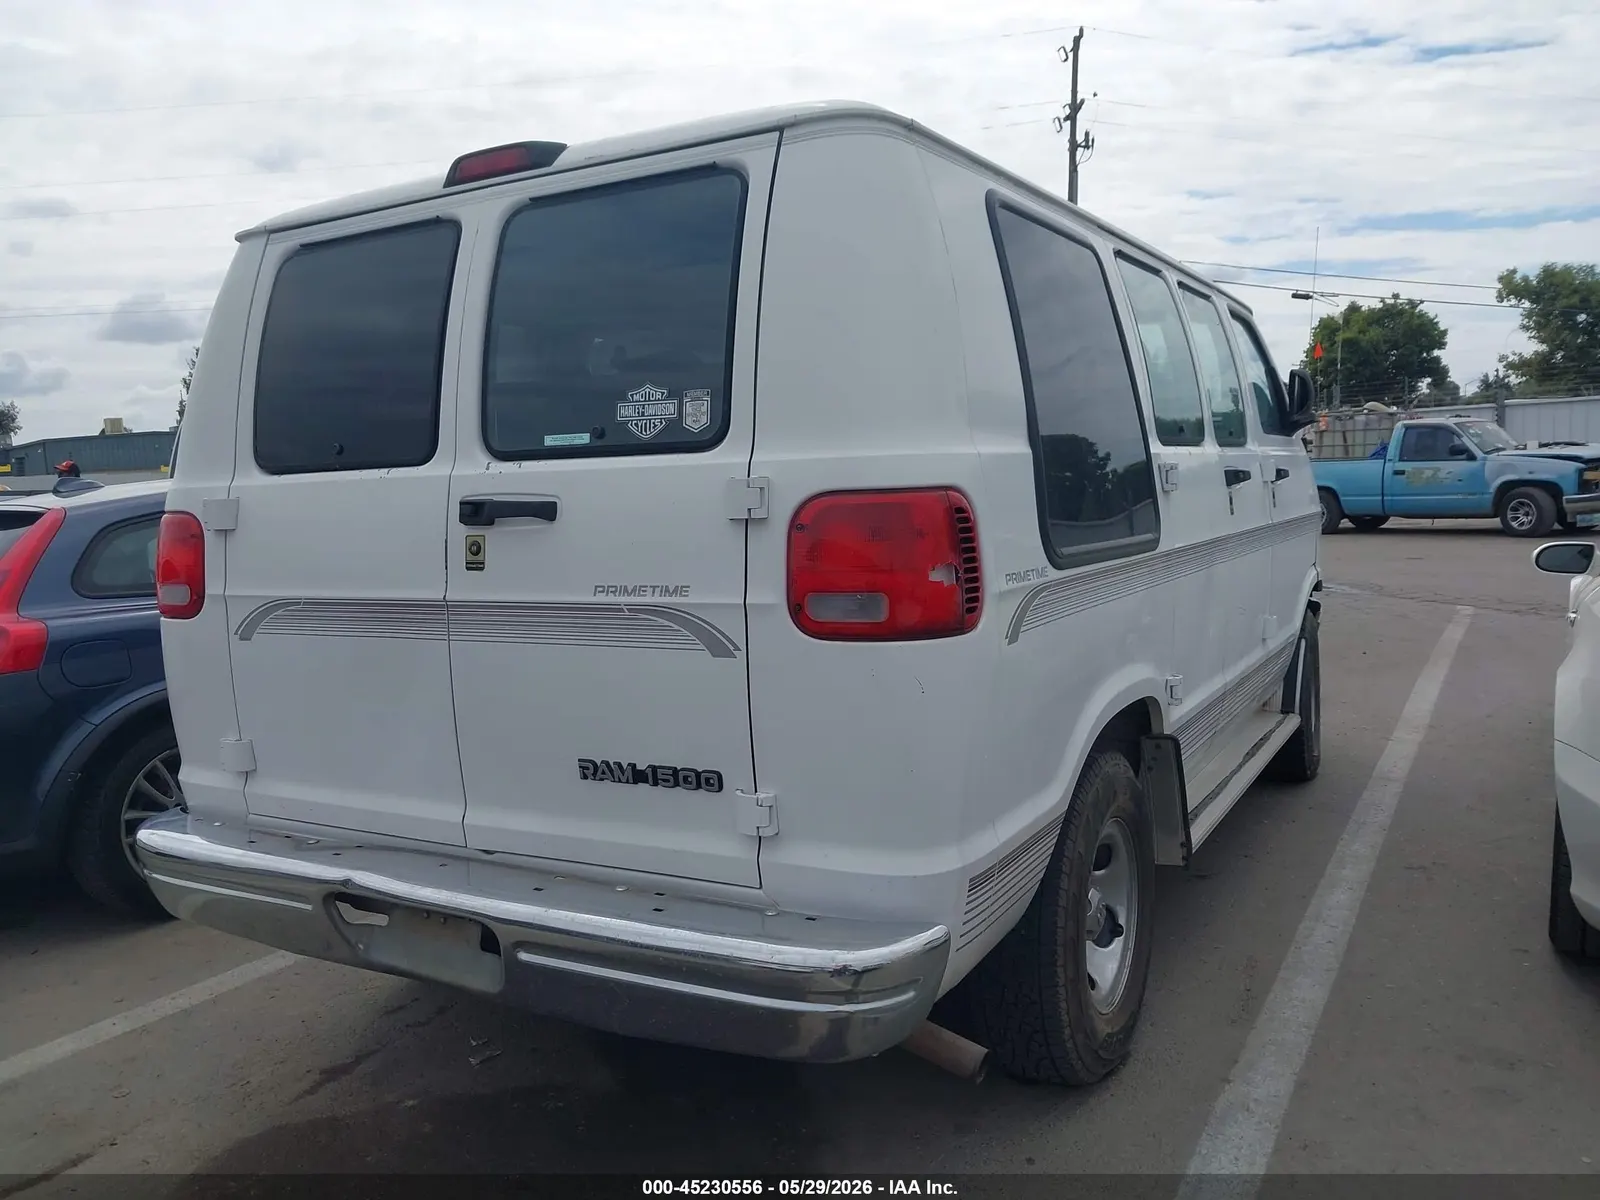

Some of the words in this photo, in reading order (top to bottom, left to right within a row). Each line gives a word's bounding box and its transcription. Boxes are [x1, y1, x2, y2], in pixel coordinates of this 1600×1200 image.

[633, 388, 662, 401] MOTOR
[620, 403, 675, 417] HARLEY-DAVIDSON
[632, 420, 661, 435] CYCLES
[1004, 566, 1049, 586] PRIMETIME
[593, 585, 690, 598] PRIMETIME
[578, 758, 637, 785] RAM
[644, 764, 723, 793] 1500
